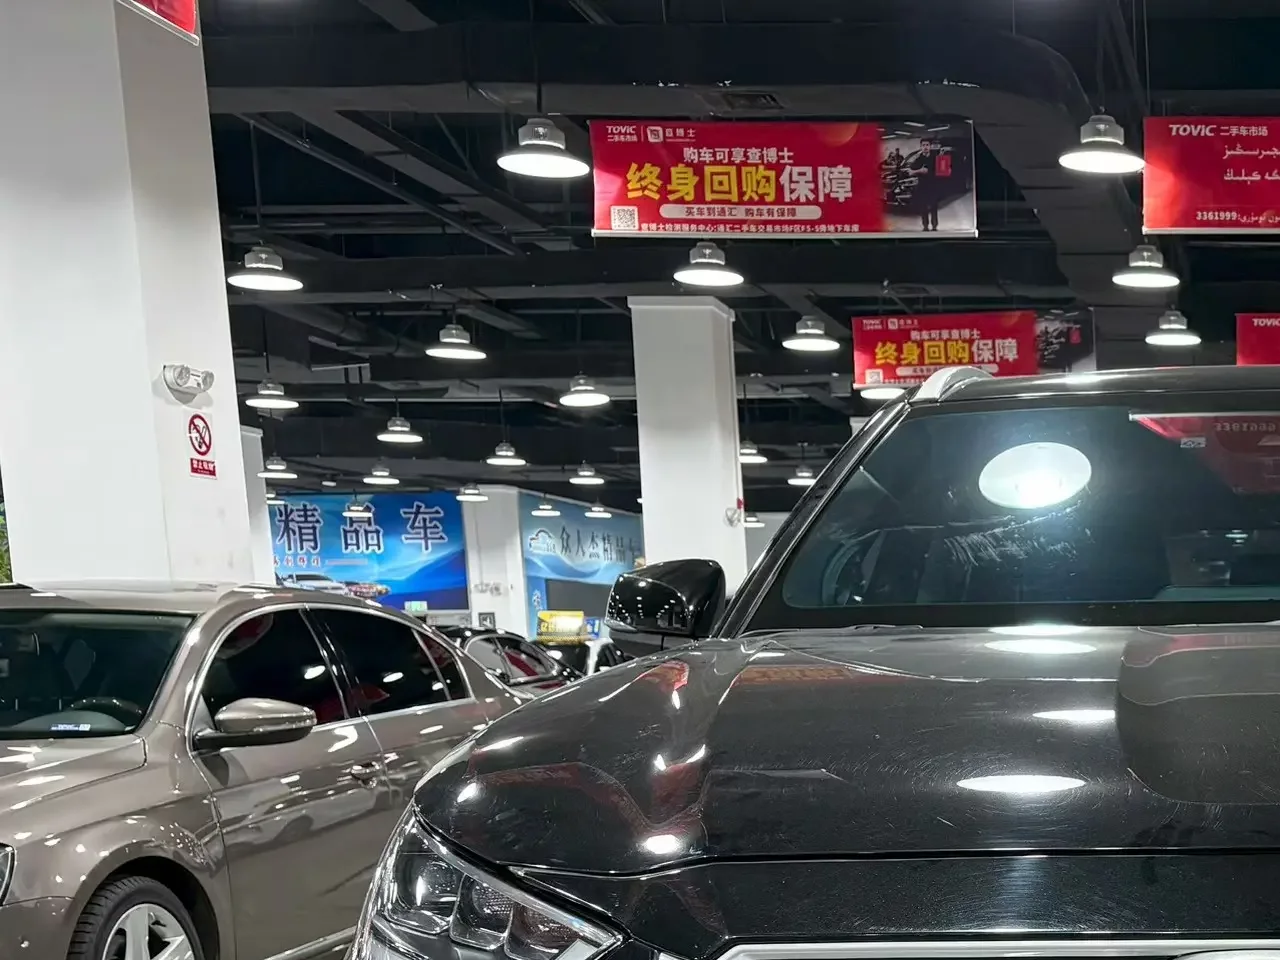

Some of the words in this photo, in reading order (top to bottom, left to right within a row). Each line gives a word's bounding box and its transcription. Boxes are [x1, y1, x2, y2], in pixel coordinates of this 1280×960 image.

[1168, 124, 1217, 137] TOVIC
[1220, 125, 1269, 137] 二手车市场
[683, 147, 795, 163] 购车可享查博士
[625, 161, 853, 204] 终身回购保障
[685, 206, 738, 218] 买车到通汇
[744, 207, 798, 218] 购车有保障
[874, 337, 1019, 365] 终身回购保障
[276, 501, 448, 554] 精品车
